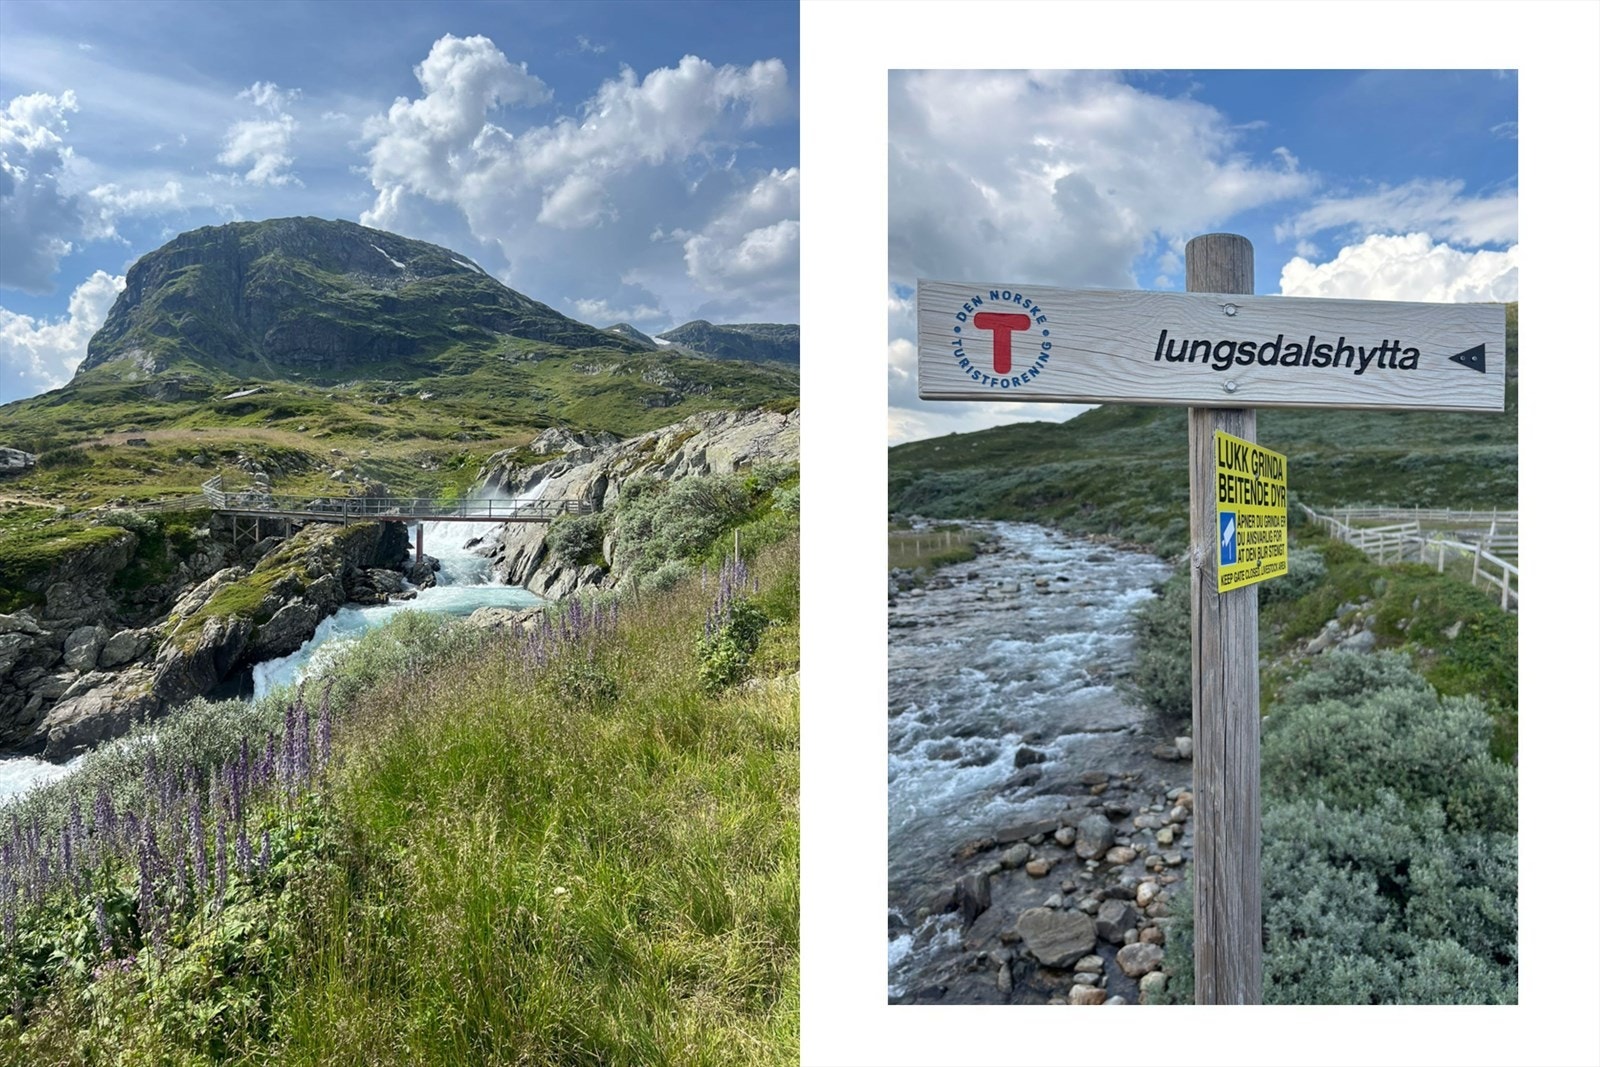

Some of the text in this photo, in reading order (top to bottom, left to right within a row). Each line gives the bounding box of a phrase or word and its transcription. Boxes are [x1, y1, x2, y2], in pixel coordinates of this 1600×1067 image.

[956, 290, 1047, 325] DEN NORSKE
[973, 311, 1031, 375] T
[1154, 329, 1420, 375] lungsdalshytta
[952, 339, 1052, 389] TURISTFORENING
[1218, 437, 1283, 481] LUKK GRINDA
[1218, 473, 1286, 508] BEITENDE DYR
[1237, 510, 1255, 528] ÅPNER
[1256, 514, 1263, 528] DU
[1264, 514, 1280, 528] GRINDA
[1237, 531, 1245, 546] DU
[1246, 530, 1273, 545] ANSVARLIG
[1237, 549, 1244, 563] AT
[1246, 547, 1256, 562] DEN
[1220, 573, 1233, 586] KEEP
[1234, 570, 1245, 582] GATE
